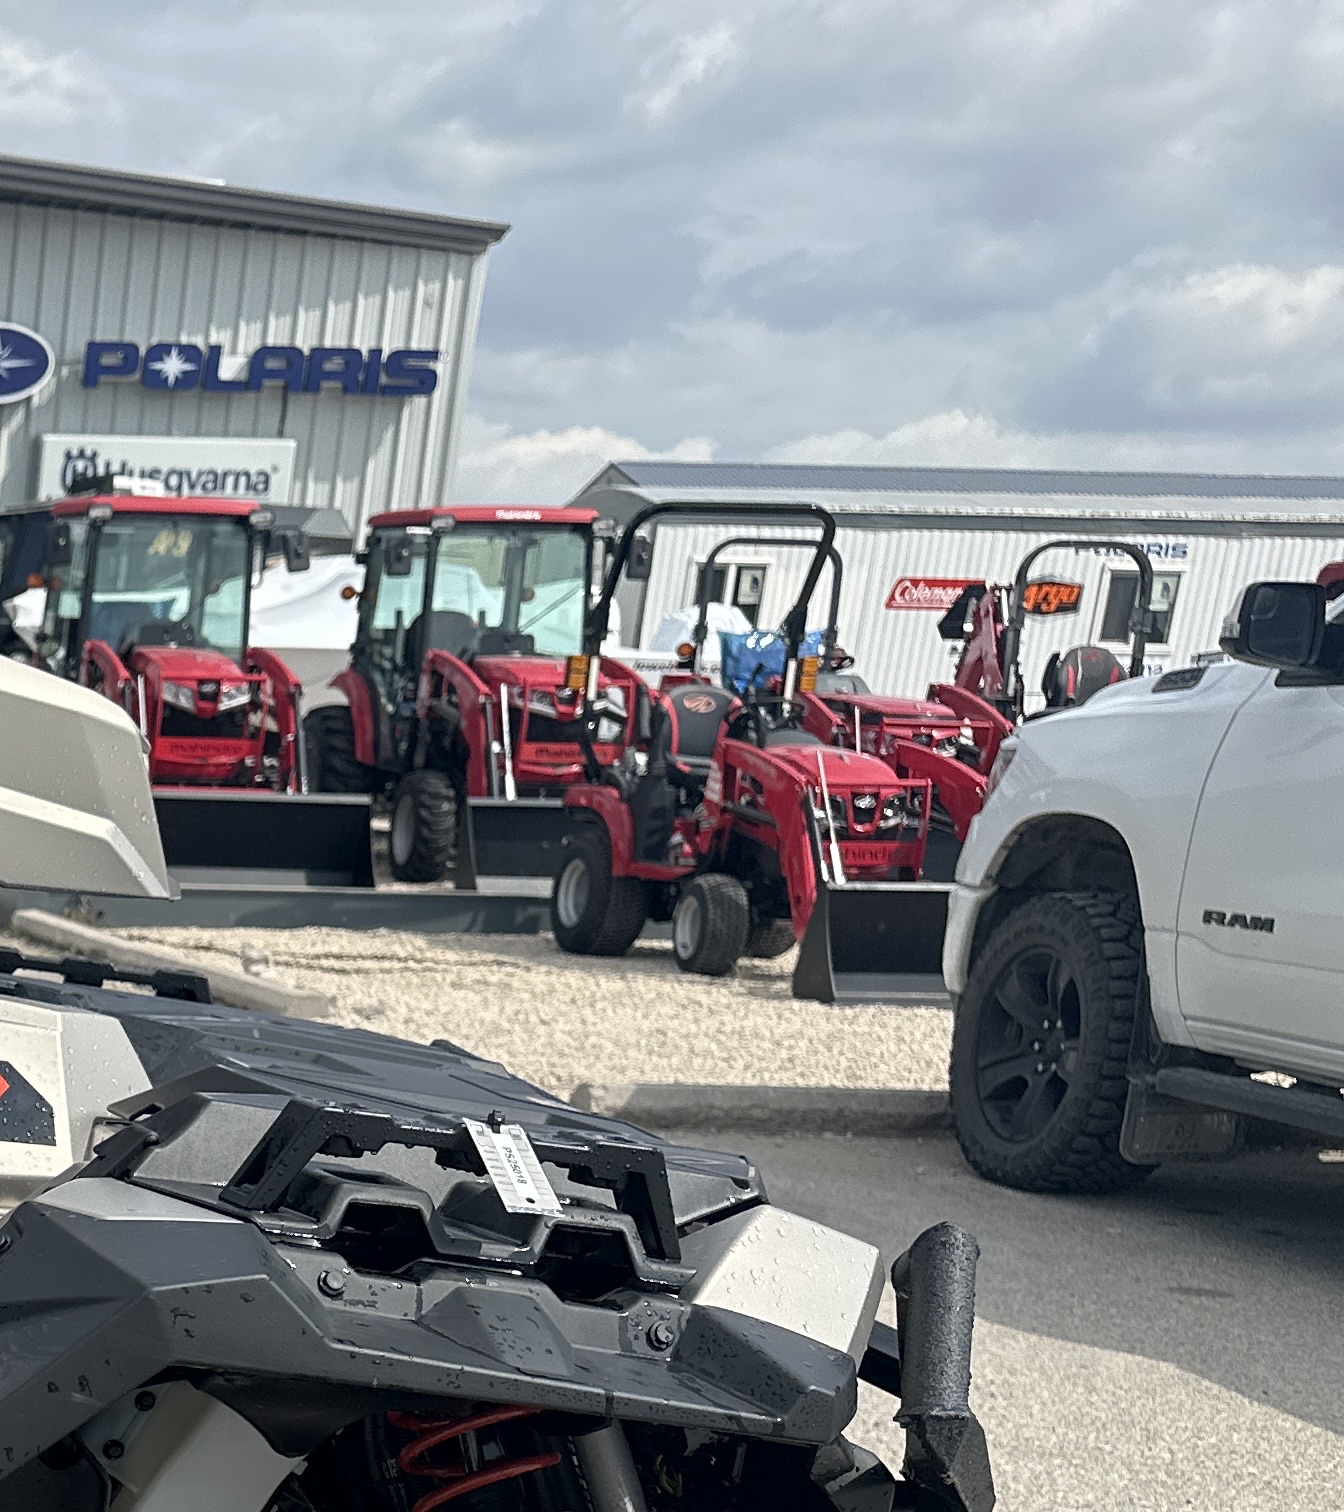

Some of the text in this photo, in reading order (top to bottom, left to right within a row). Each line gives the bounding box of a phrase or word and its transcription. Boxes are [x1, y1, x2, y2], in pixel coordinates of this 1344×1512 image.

[82, 341, 440, 397] POLARIS
[1073, 542, 1188, 559] PRIS
[1202, 909, 1275, 934] RAM
